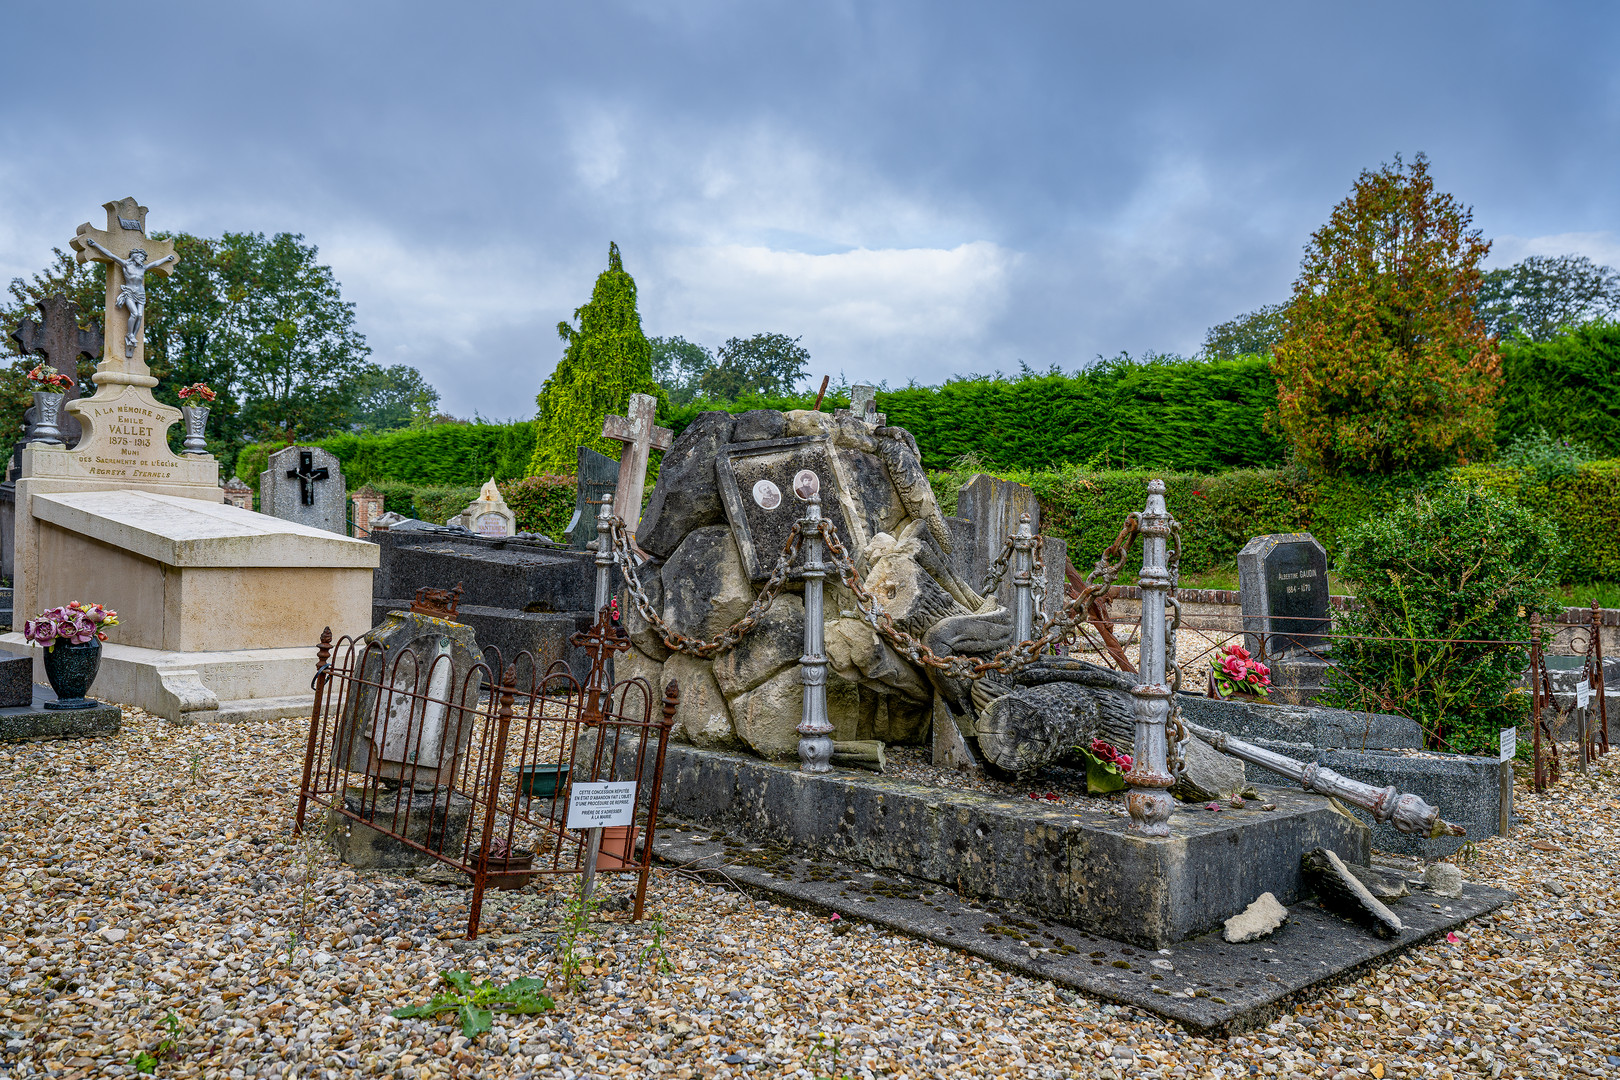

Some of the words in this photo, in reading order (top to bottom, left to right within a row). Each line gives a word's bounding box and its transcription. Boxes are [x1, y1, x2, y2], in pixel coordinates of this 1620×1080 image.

[118, 404, 152, 417] MÉMOIRE
[156, 414, 166, 422] DE
[108, 424, 153, 436] VALLET
[89, 467, 126, 476] REGRETS
